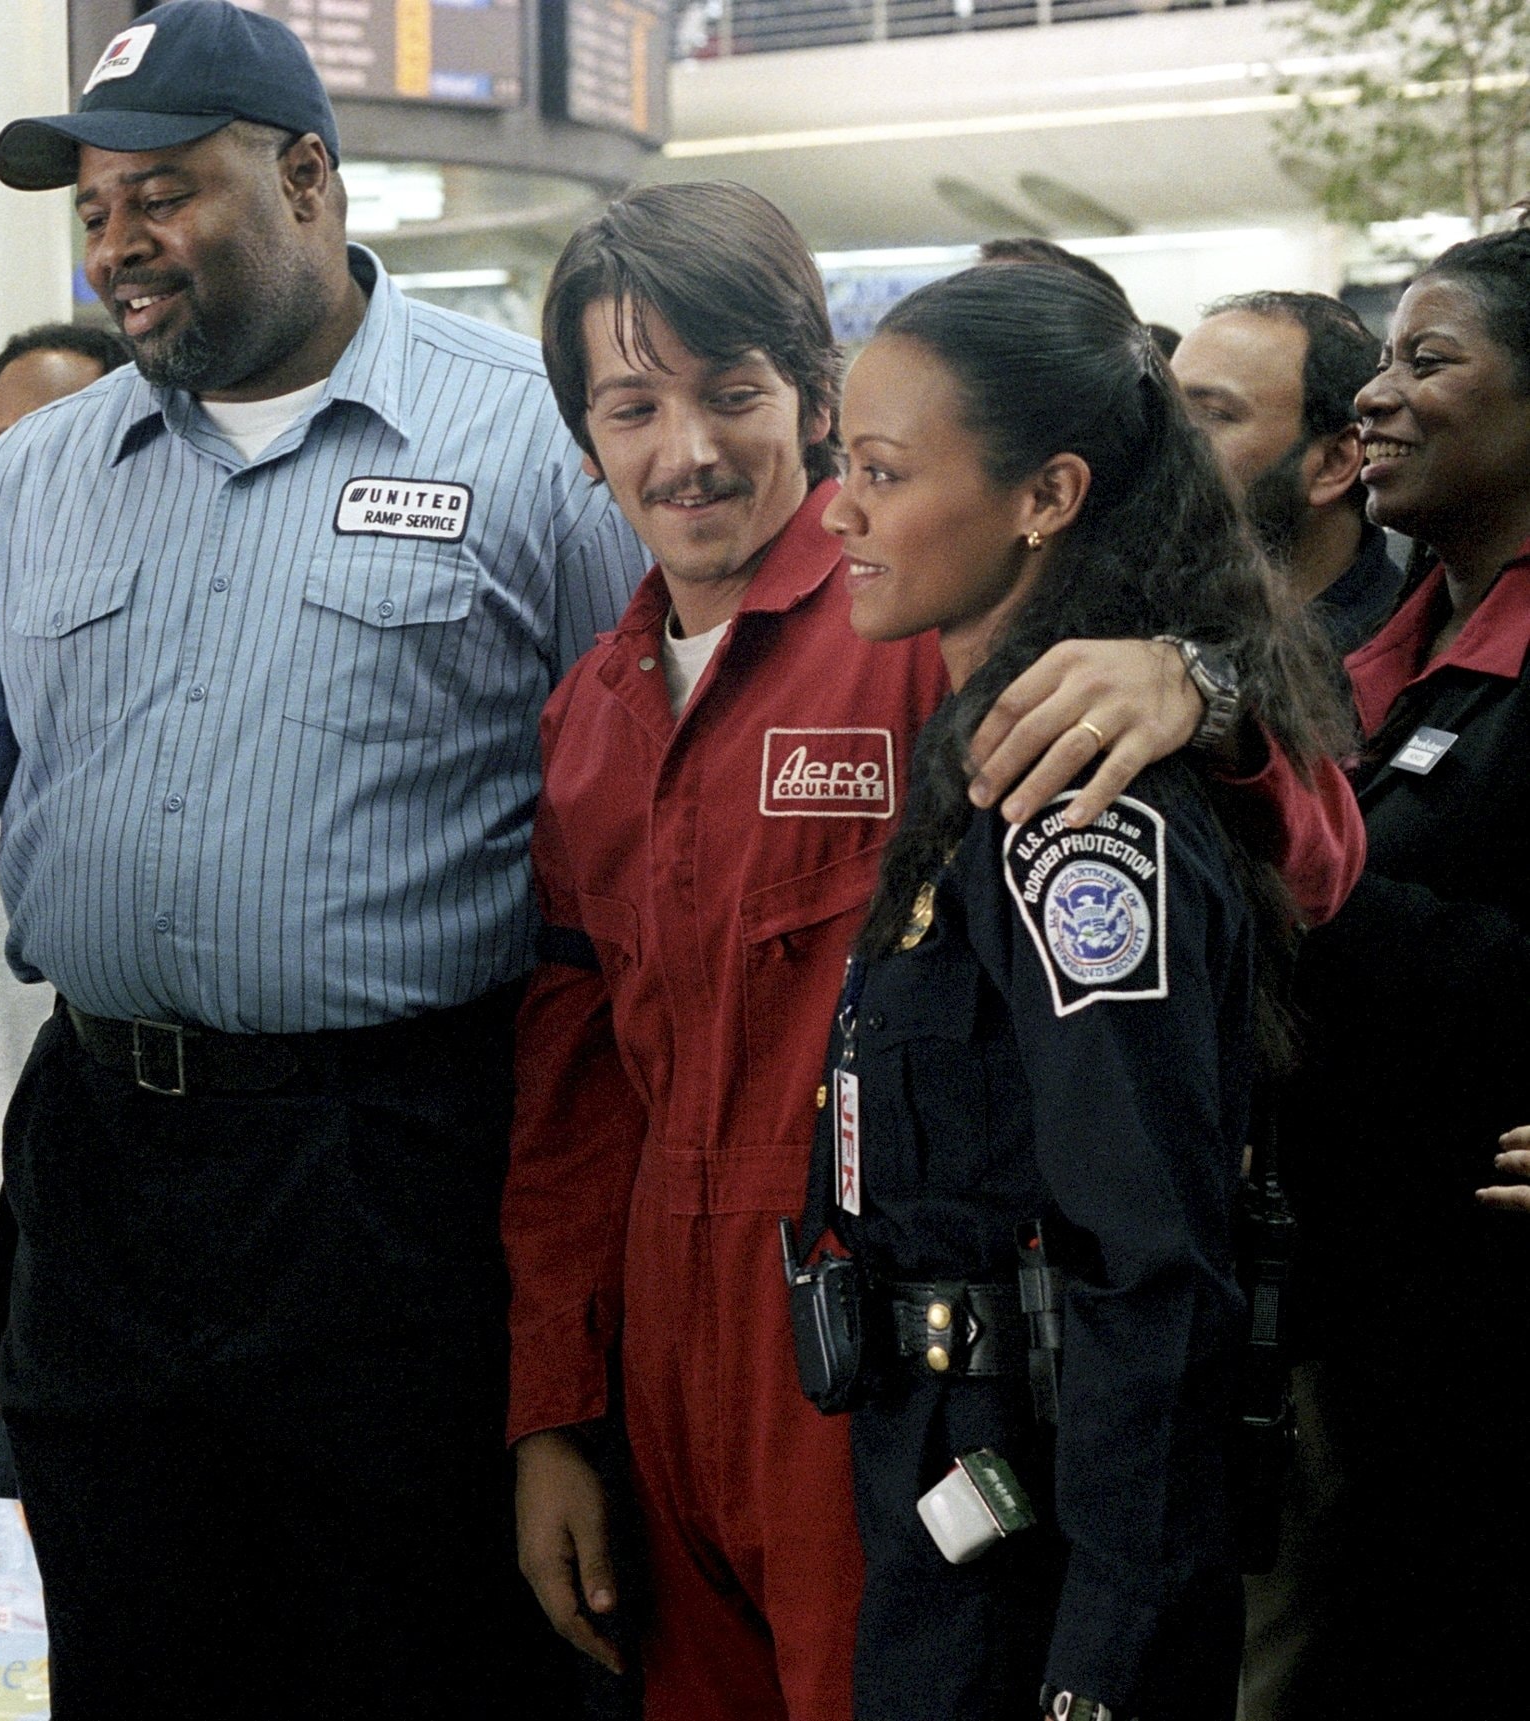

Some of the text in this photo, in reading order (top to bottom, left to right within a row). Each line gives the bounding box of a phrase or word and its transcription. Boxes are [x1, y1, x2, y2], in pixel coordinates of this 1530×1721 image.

[370, 488, 461, 510] UNITED
[363, 511, 457, 531] RAMP SERVICE
[777, 746, 880, 781] Aero
[779, 783, 876, 796] GOURMET
[1016, 811, 1141, 860] U.S. CUMS AND
[1023, 834, 1156, 903] BORDER PROTECTION
[842, 1094, 855, 1201] JFK
